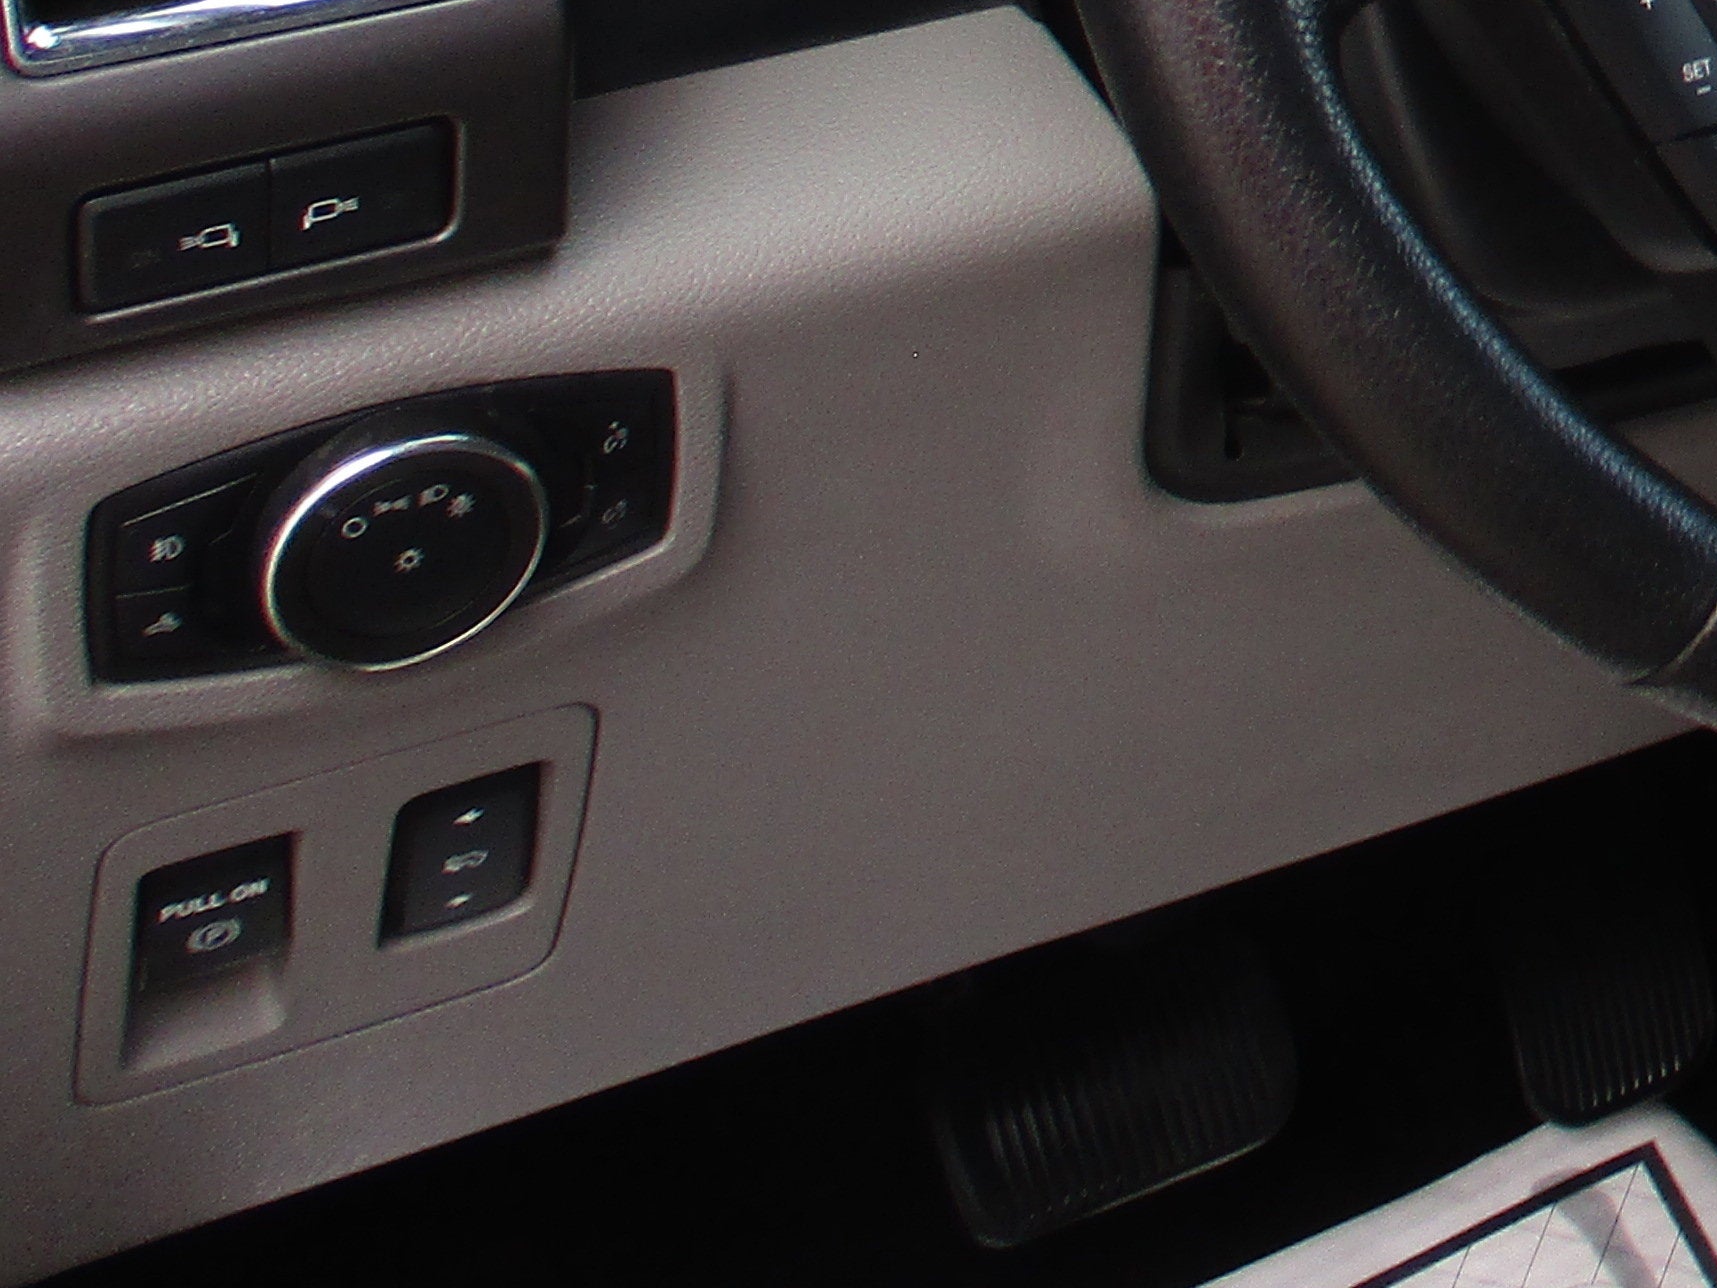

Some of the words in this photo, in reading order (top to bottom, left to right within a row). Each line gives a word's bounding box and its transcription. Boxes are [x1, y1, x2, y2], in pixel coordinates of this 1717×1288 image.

[1682, 56, 1712, 83] SET
[157, 891, 228, 923] PULL
[228, 876, 271, 904] ON
